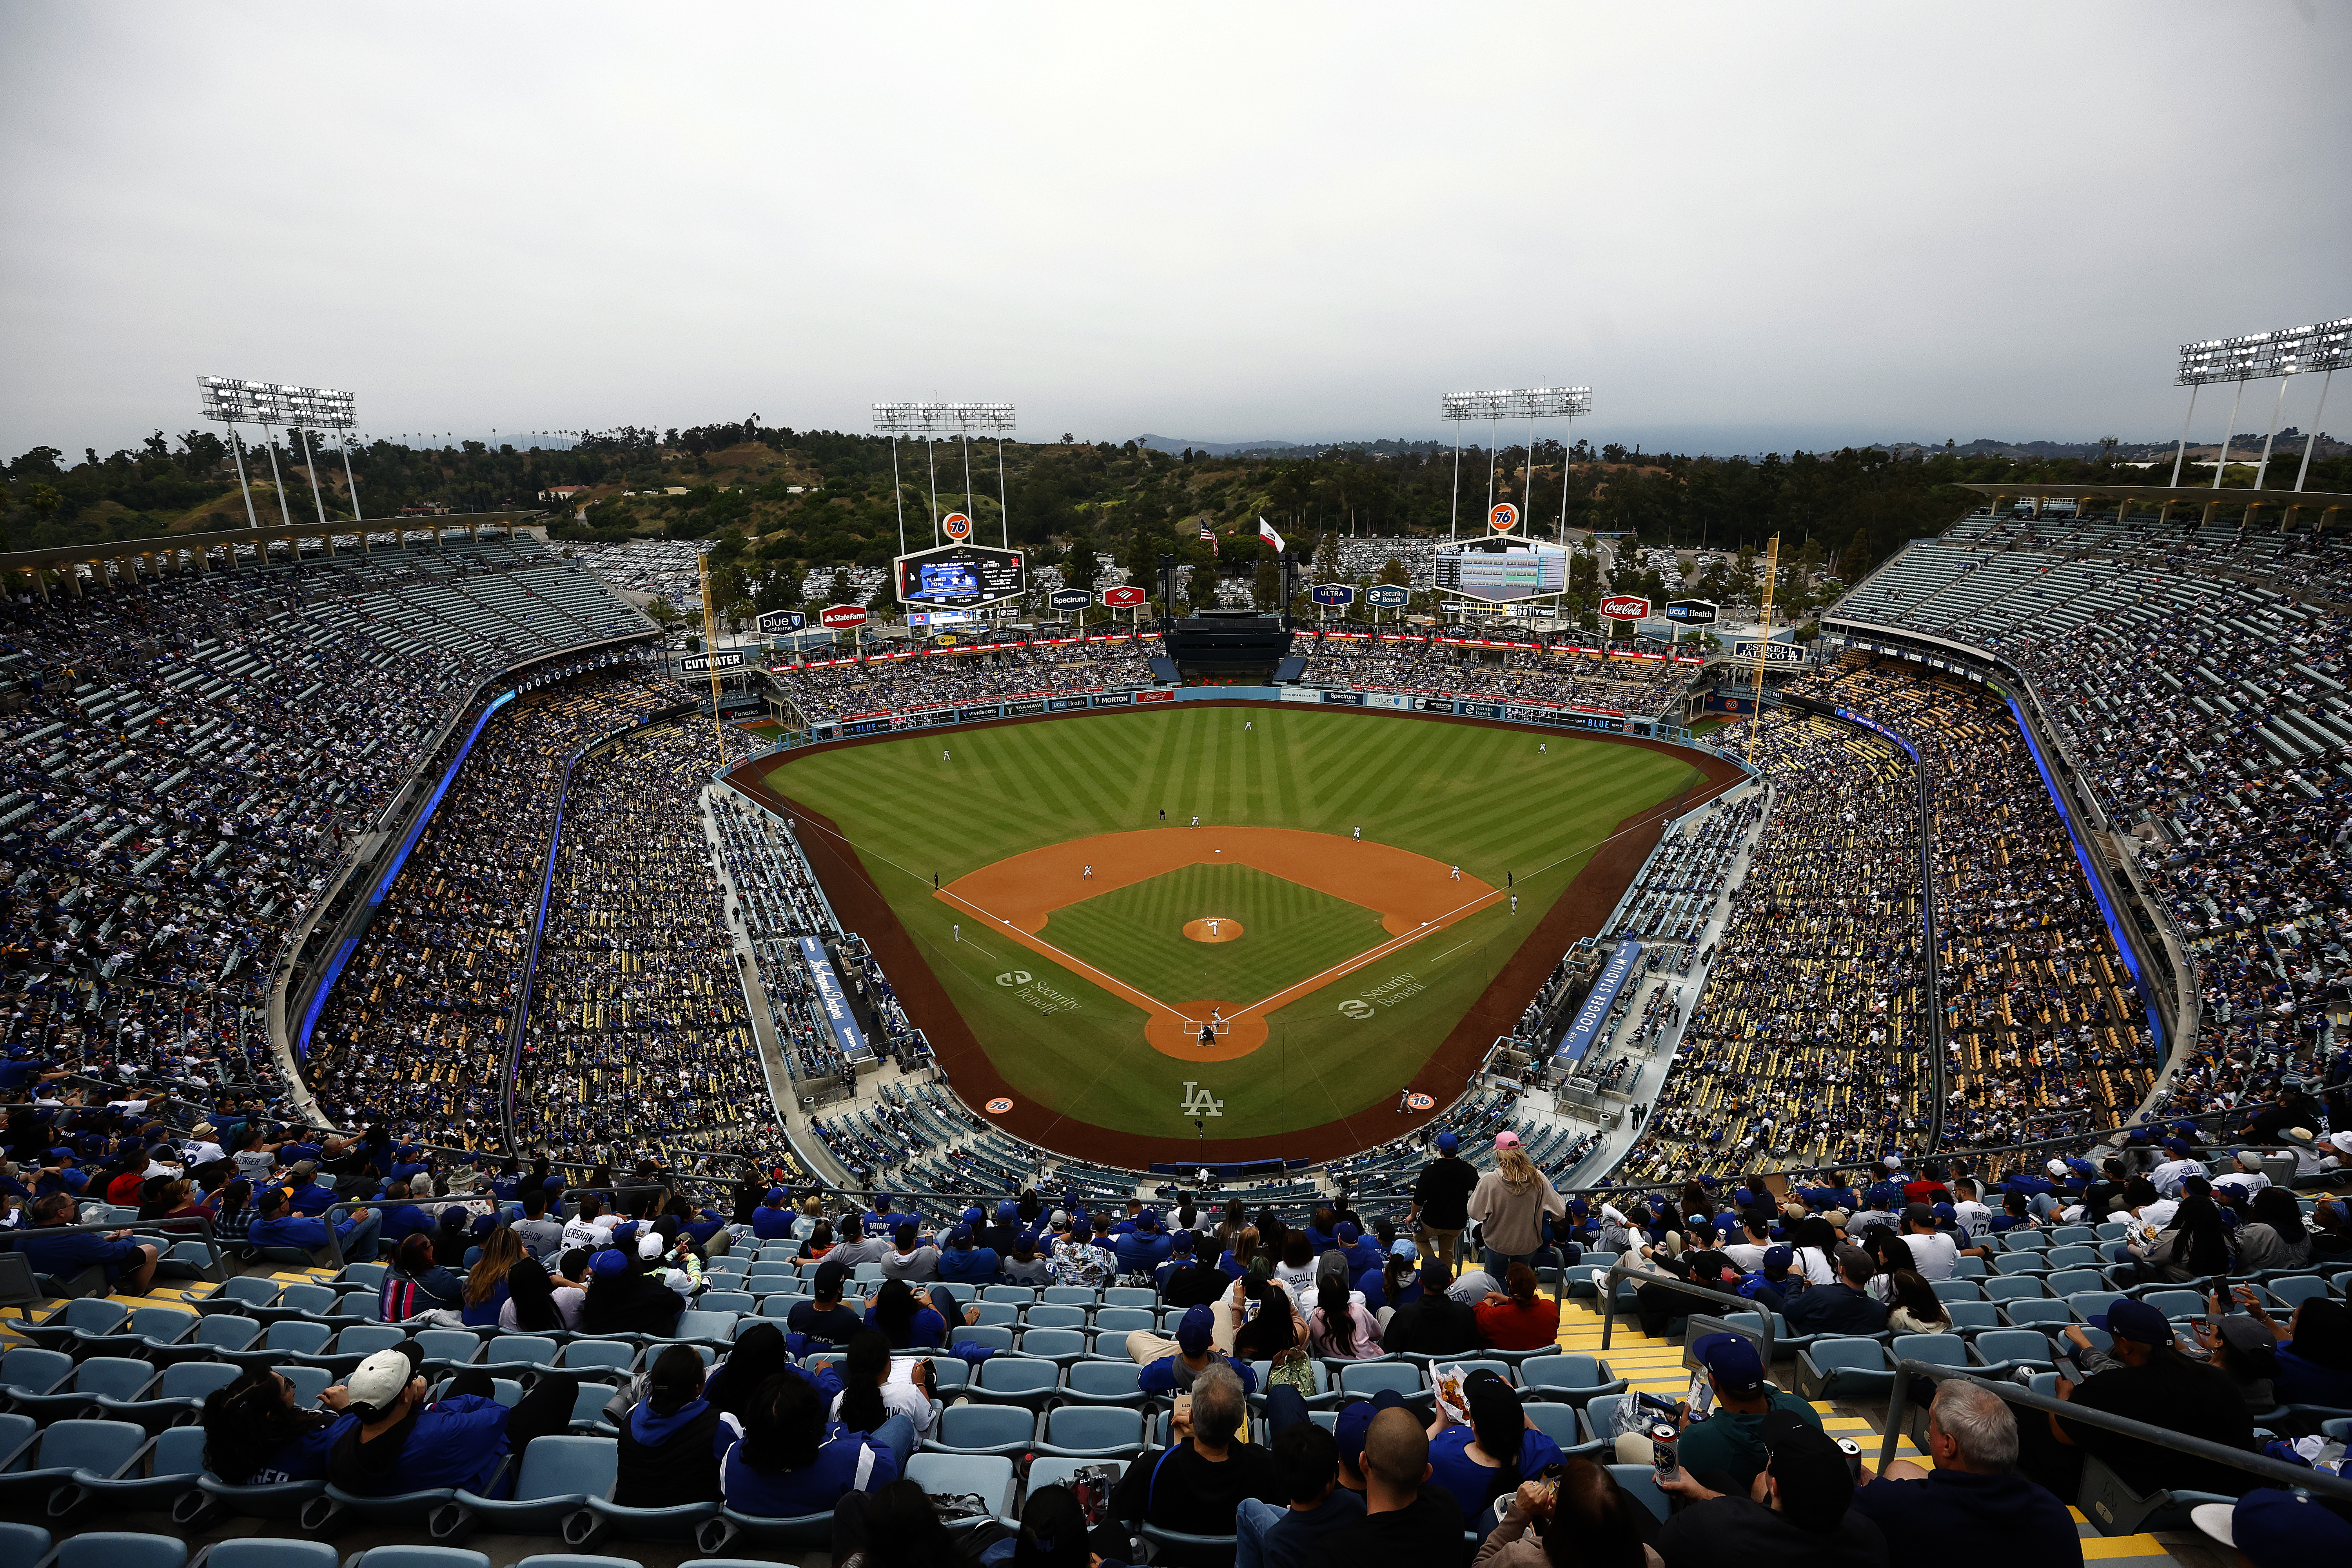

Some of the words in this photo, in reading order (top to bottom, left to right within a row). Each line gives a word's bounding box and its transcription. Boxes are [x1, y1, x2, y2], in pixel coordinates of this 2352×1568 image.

[1494, 510, 1512, 524] 76
[950, 520, 965, 532] 76
[1054, 597, 1085, 605] Spectrum
[1604, 602, 1641, 615] Coca-Cola
[763, 617, 789, 627] blue
[685, 655, 740, 669] CUTWATER
[1740, 650, 1784, 660] JALISCO
[857, 724, 876, 732] BLUE
[1588, 719, 1609, 728] BLUE
[804, 937, 814, 952] Spectrum
[809, 959, 831, 973] Los
[815, 970, 834, 994] Angeles
[1361, 973, 1416, 1000] Security
[1014, 987, 1059, 1014] Benefit
[1031, 981, 1082, 1011] Security
[1377, 982, 1427, 1007] Benefit
[1576, 995, 1607, 1032] DODGER
[1599, 958, 1628, 993] STADIUM
[824, 991, 845, 1020] Dodgers
[842, 1027, 856, 1046] Spectrum
[988, 1101, 1012, 1111] 76
[1181, 1082, 1223, 1116] LA
[1410, 1096, 1431, 1106] 76
[2247, 1180, 2269, 1192] SCULLY
[1971, 1212, 1991, 1222] VARGAS
[564, 1228, 595, 1243] KERSHAW
[1289, 1272, 1314, 1285] SCULL
